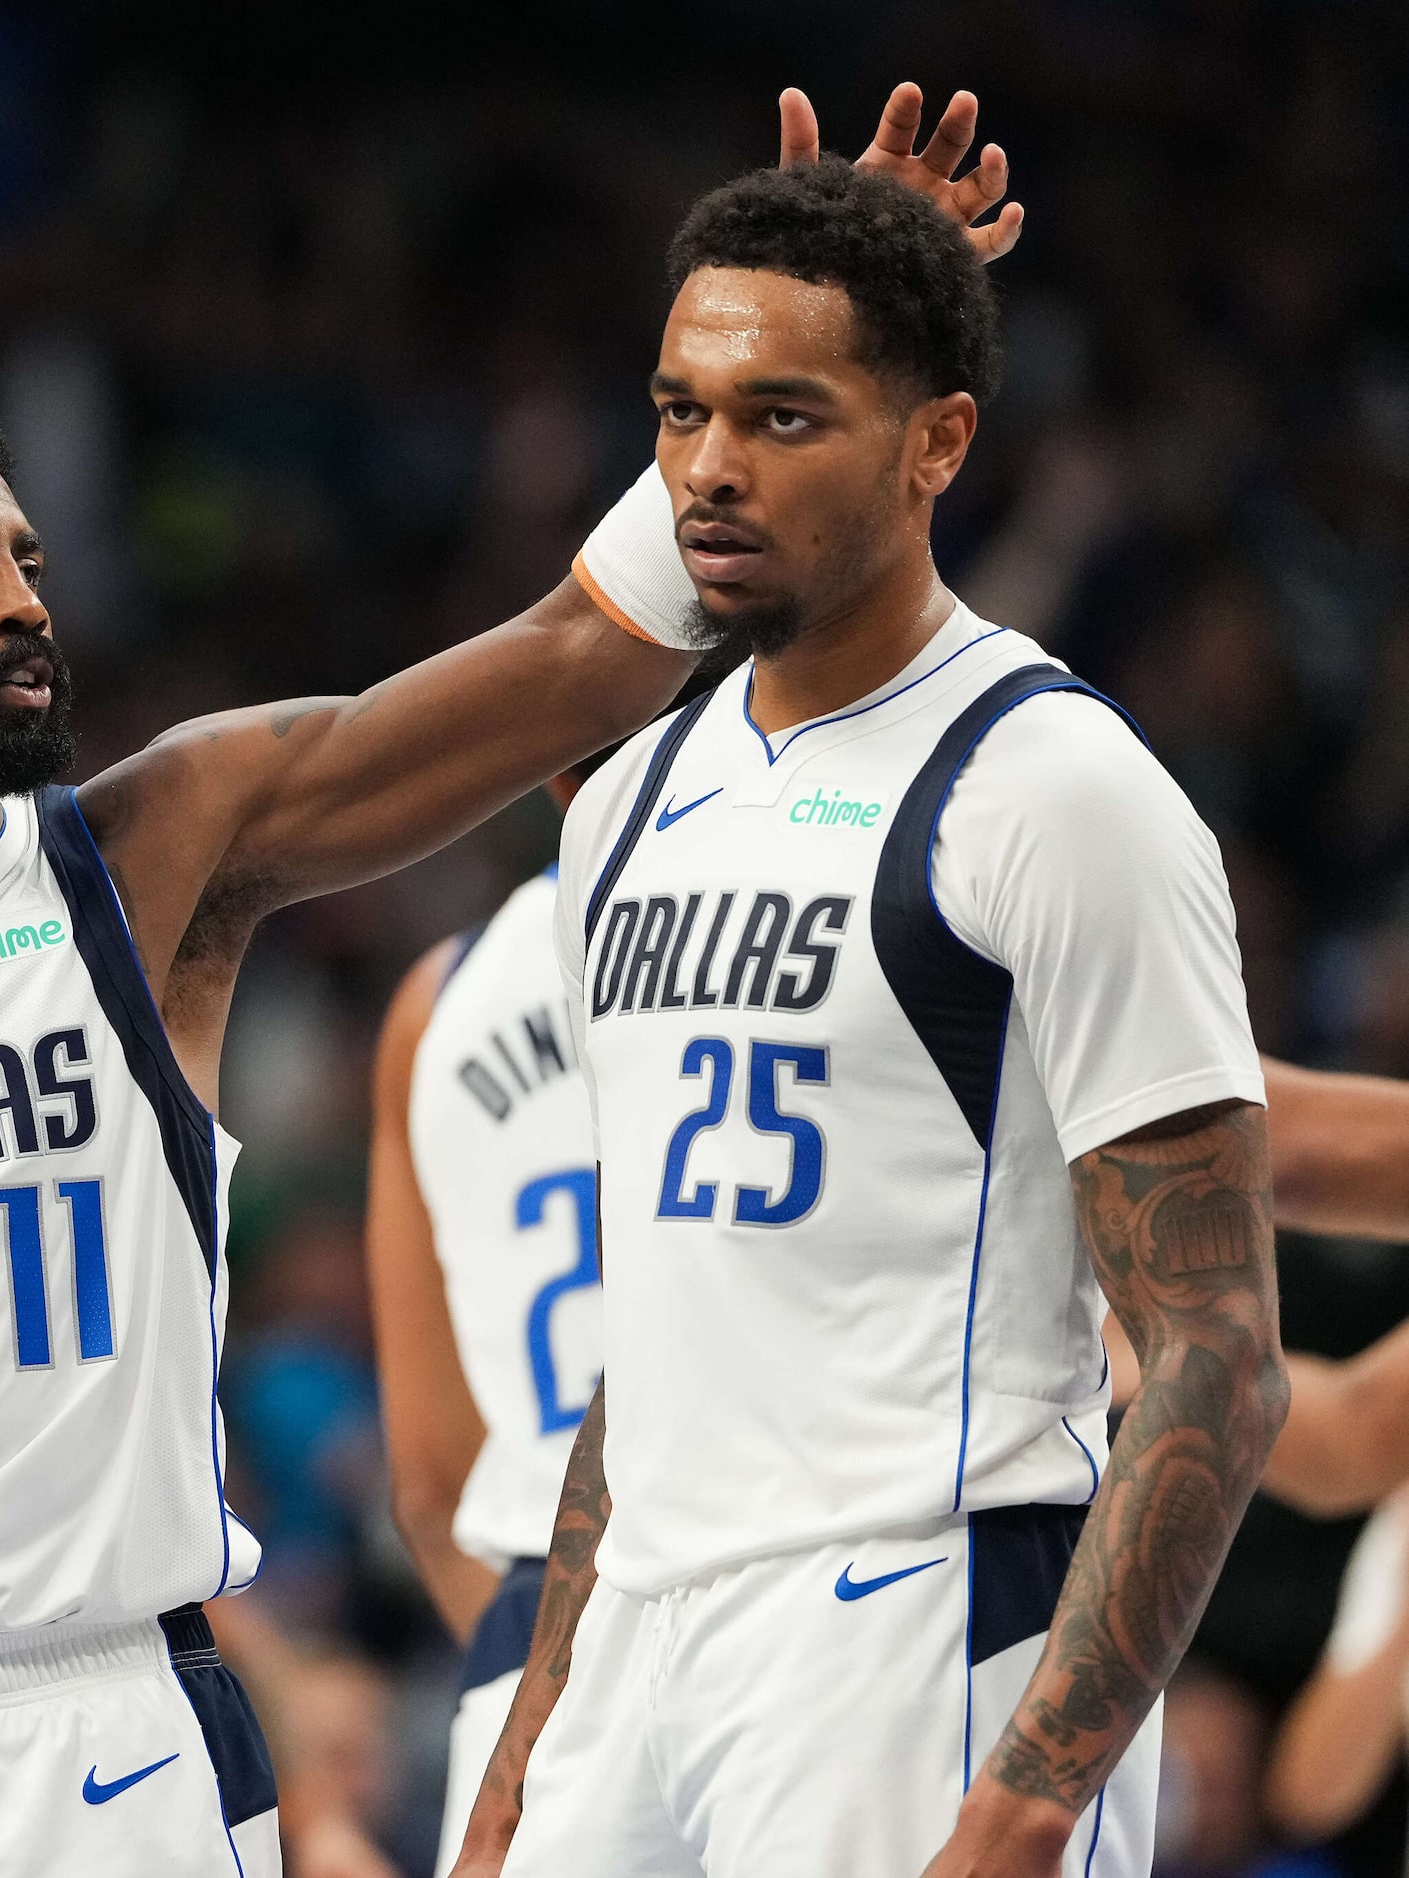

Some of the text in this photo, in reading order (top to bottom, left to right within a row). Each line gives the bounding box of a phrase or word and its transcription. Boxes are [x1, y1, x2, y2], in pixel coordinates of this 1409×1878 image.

[790, 788, 881, 828] chime
[590, 888, 858, 1023] DALLAS
[653, 1034, 831, 1230] 25
[515, 1167, 601, 1436] 2
